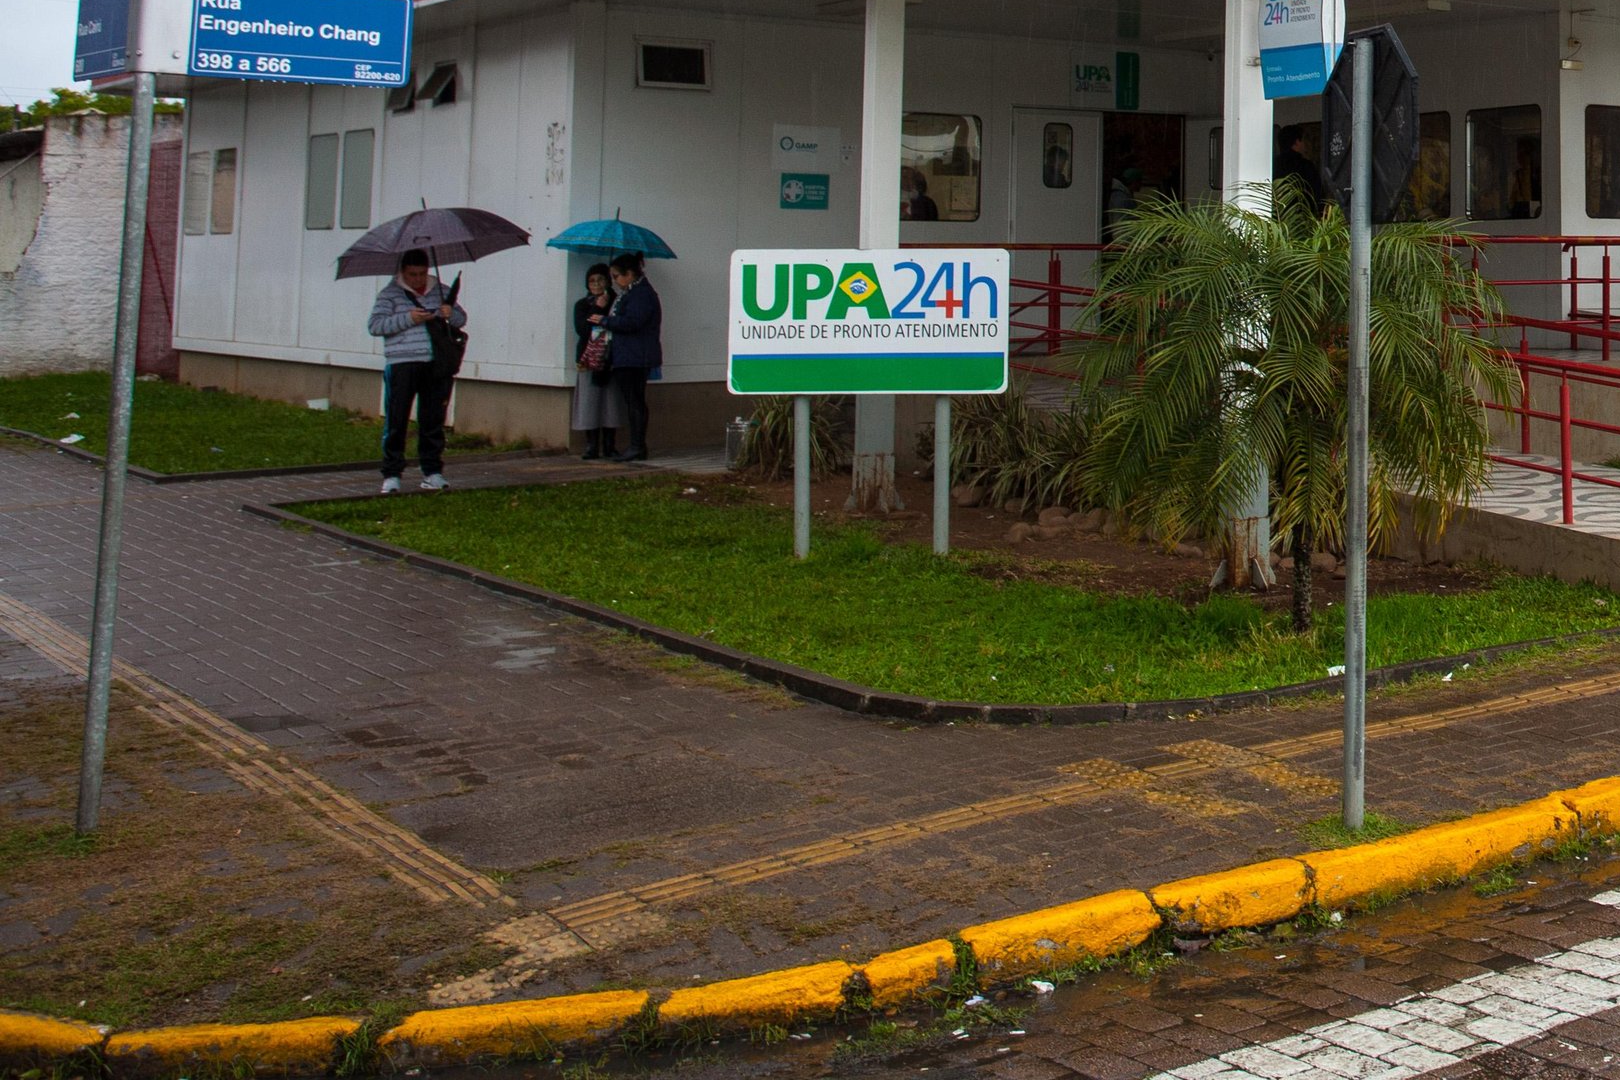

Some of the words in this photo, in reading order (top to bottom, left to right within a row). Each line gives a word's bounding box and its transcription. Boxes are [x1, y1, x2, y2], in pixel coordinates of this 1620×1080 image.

[1264, 2, 1290, 26] 24h
[199, 14, 314, 37] Engenheiro
[319, 24, 381, 46] Chang
[197, 53, 233, 70] 398
[238, 58, 250, 71] a
[256, 57, 292, 73] 566
[1076, 64, 1111, 81] UPA
[354, 71, 401, 81] 92200-620
[1286, 71, 1321, 82] Atendimento
[742, 263, 891, 321] UPA
[891, 262, 998, 319] 24h
[741, 324, 806, 340] UNIDADE
[810, 324, 828, 339] DE
[833, 323, 891, 339] PRONTO
[895, 322, 999, 338] ATENDIMENTO
